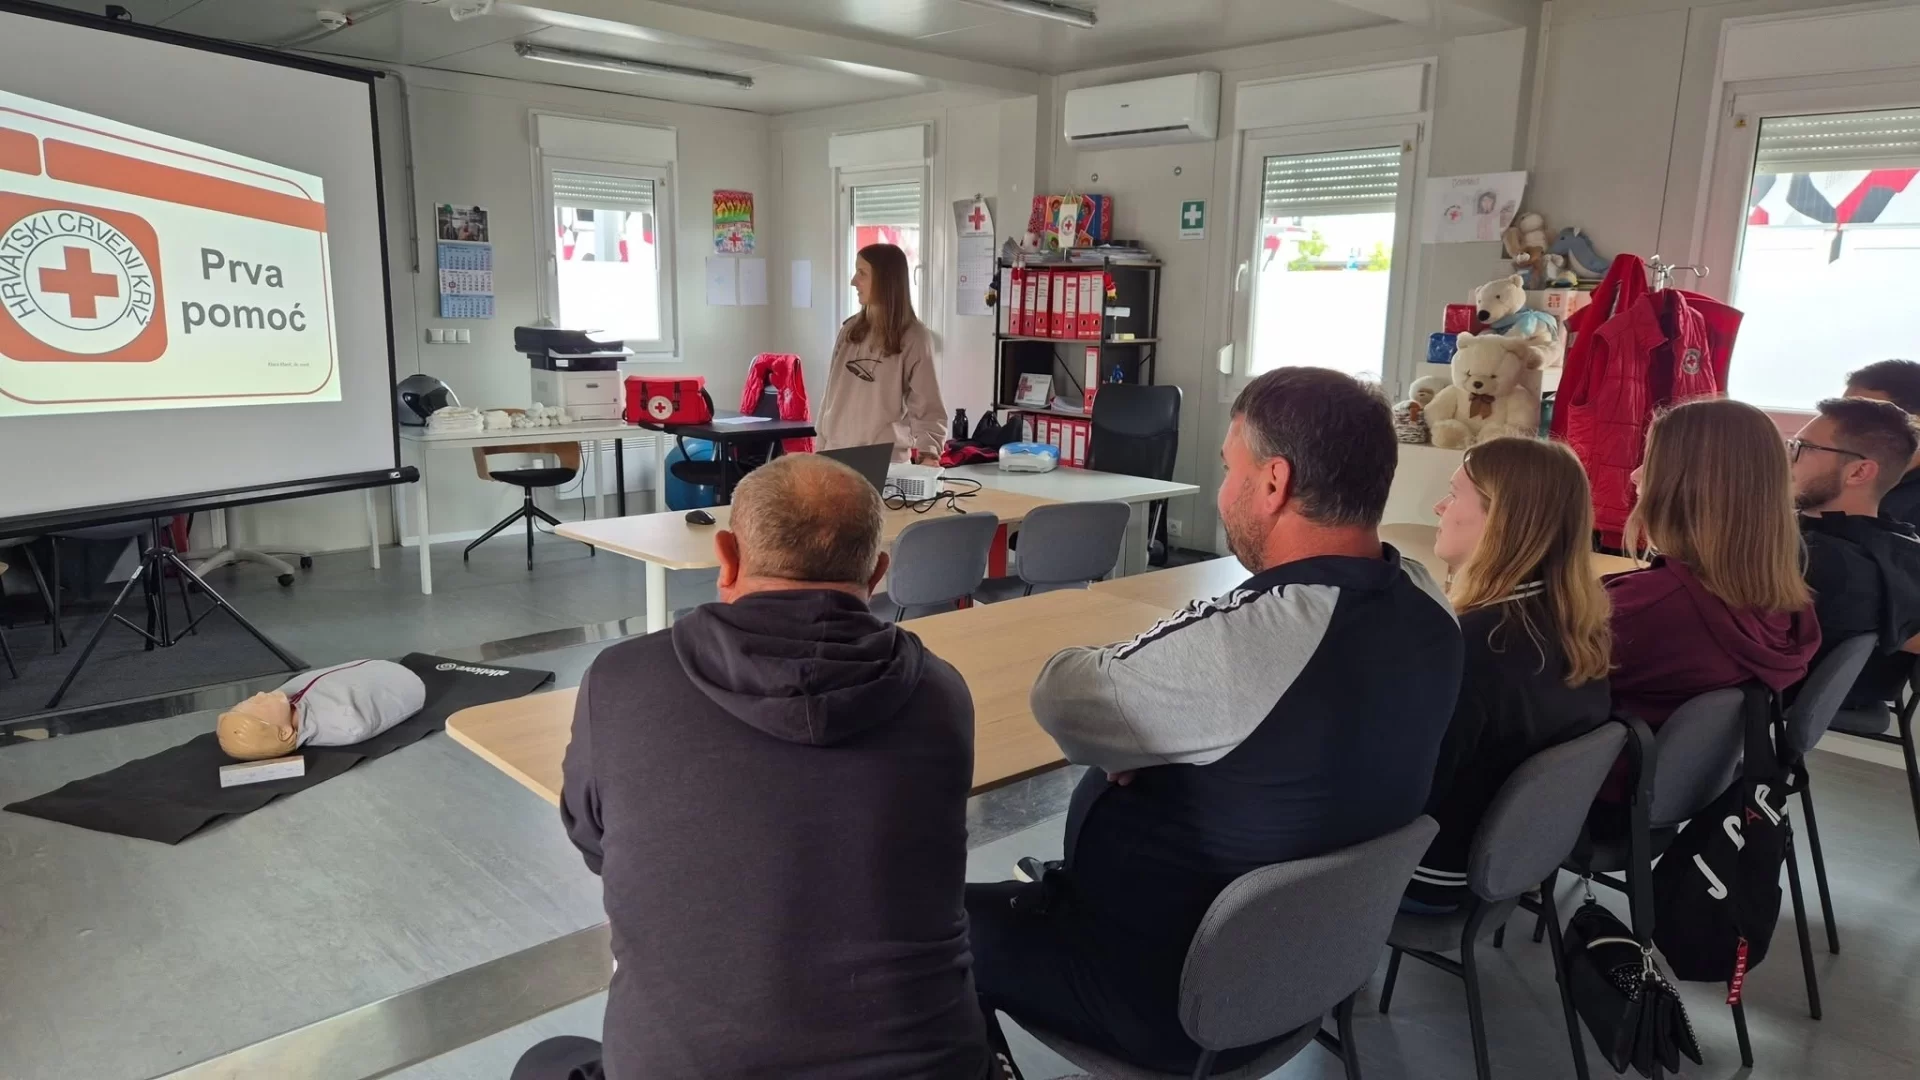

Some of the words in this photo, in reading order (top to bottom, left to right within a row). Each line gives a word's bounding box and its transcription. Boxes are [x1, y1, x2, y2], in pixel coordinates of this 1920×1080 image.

[0, 215, 53, 319] HRVATSKI
[57, 212, 144, 270] CRVENI
[201, 247, 284, 288] Prva
[181, 301, 307, 334] pomoć
